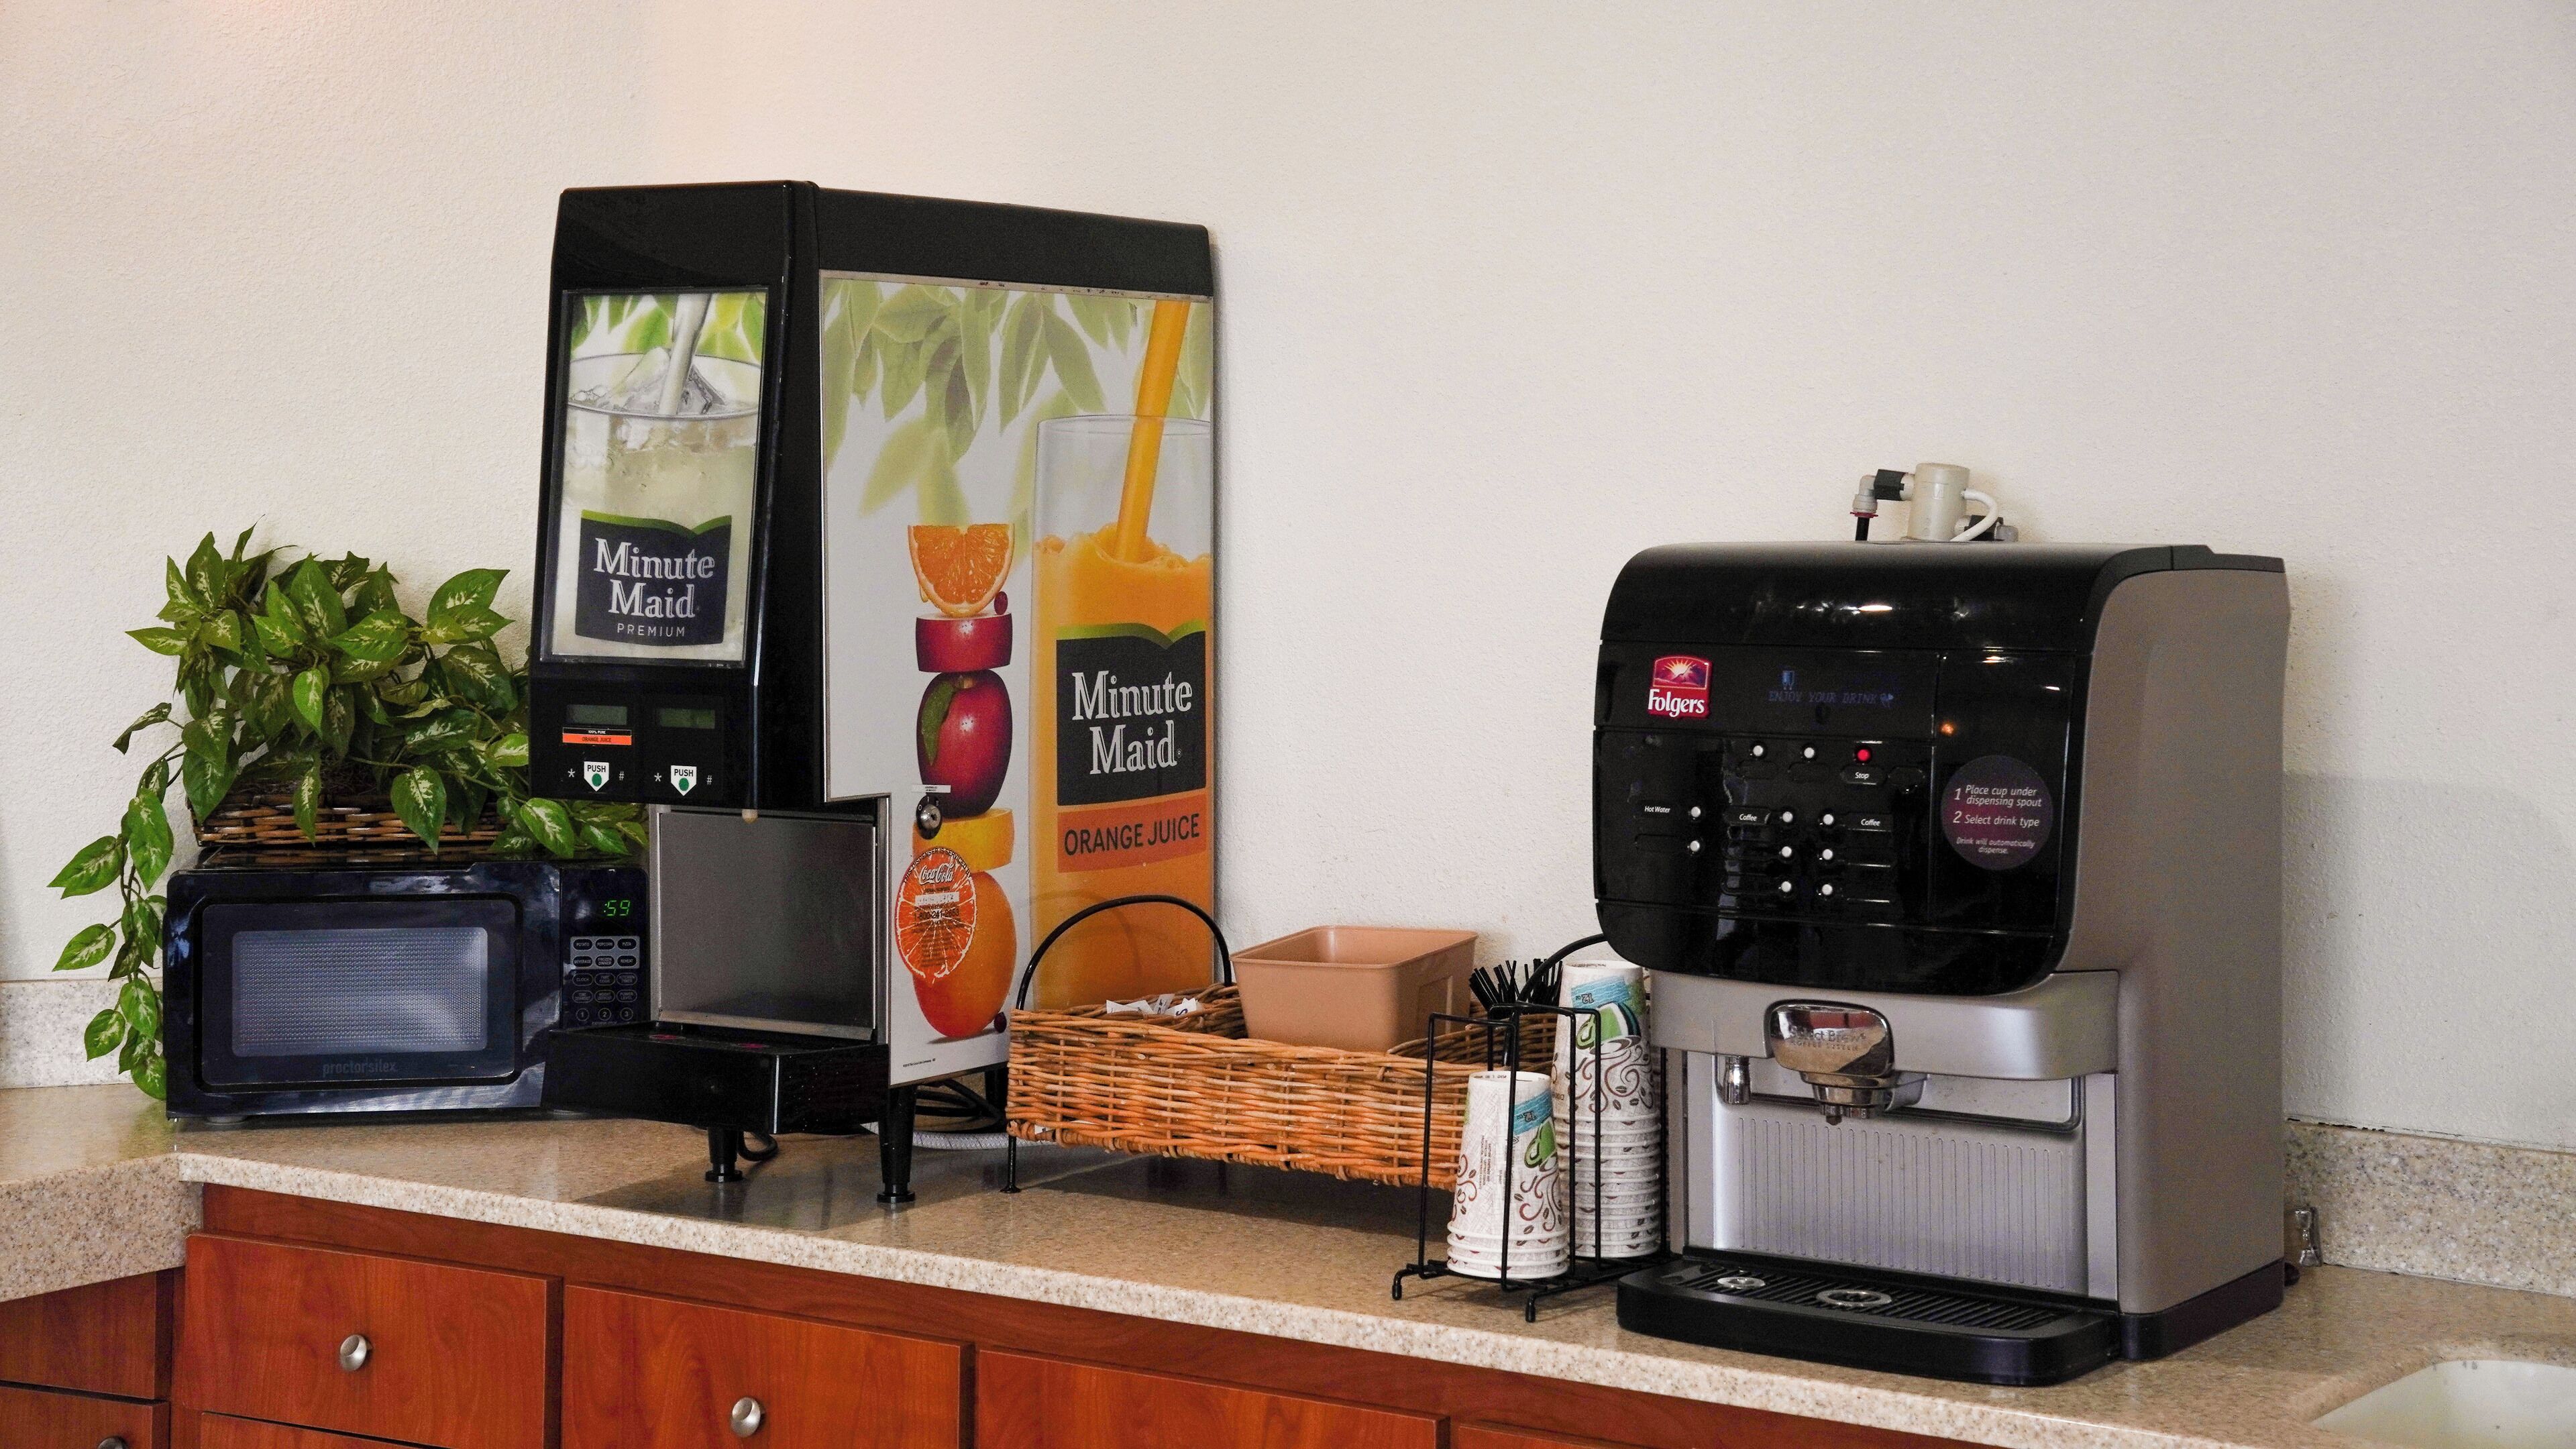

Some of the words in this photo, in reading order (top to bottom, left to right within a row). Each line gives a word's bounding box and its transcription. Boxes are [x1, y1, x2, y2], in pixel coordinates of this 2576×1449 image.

[593, 538, 715, 579] Minute
[608, 579, 696, 618] Maid
[616, 623, 686, 637] PREMIUM
[1072, 671, 1192, 720] Minute
[1809, 692, 1837, 702] YOUR
[1648, 688, 1705, 718] Folgers
[1089, 720, 1177, 775] Maid
[674, 769, 694, 777] PUSH
[1855, 771, 1870, 780] Stop
[1954, 788, 1962, 800] 1
[1966, 785, 1988, 794] Place
[1992, 788, 2008, 798] cup
[2010, 787, 2037, 796] under
[1966, 796, 2014, 808] dispensing
[2017, 798, 2042, 808] spout
[1739, 814, 1758, 822] Coffee
[1860, 818, 1881, 826] Coffee
[1953, 810, 1962, 823] 2
[1964, 814, 1991, 824] Select
[1994, 816, 2017, 826] drink
[2020, 817, 2040, 828] type
[1064, 824, 1143, 856] ORANGE
[1148, 813, 1200, 846] JUICE
[1988, 839, 2035, 849] automatically
[919, 863, 955, 885] Coca-Cola
[1581, 993, 1594, 1004] 12
